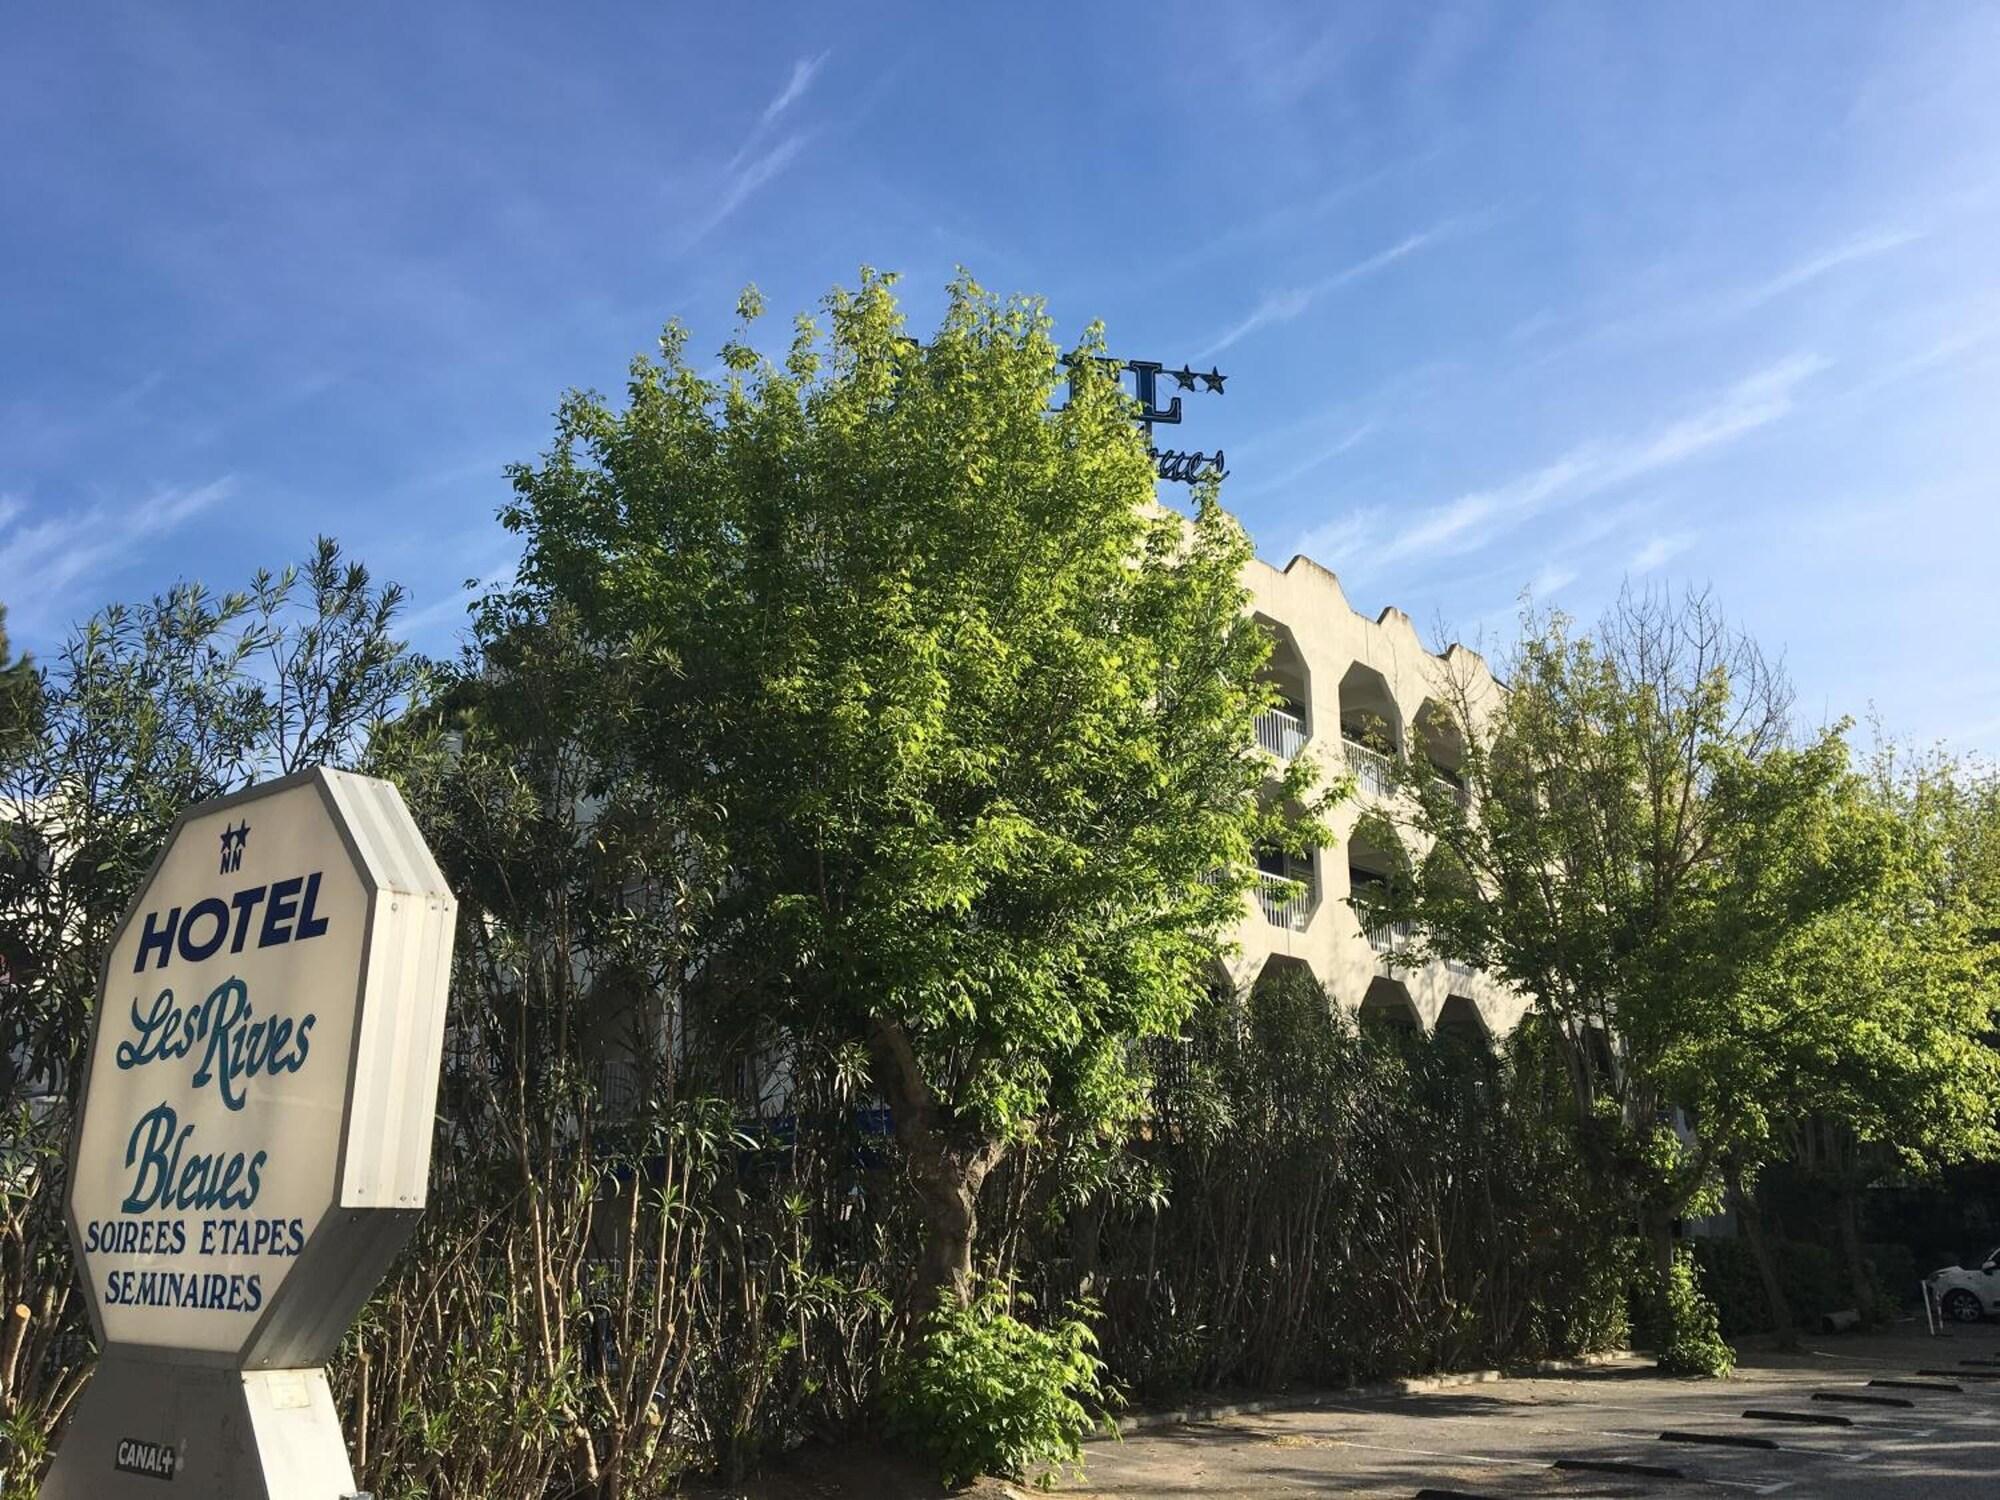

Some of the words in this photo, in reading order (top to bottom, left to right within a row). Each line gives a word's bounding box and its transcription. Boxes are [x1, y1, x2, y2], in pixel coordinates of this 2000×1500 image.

[219, 848, 242, 875] NN
[133, 871, 329, 974] HOTEL
[116, 988, 201, 1070] Les
[192, 975, 316, 1111] Rives
[121, 1100, 268, 1214] Bleues
[85, 1219, 187, 1255] SOIREES
[199, 1218, 305, 1257] ETAPES
[105, 1270, 263, 1312] SEMINAIRES
[118, 1441, 174, 1473] CANAL+
